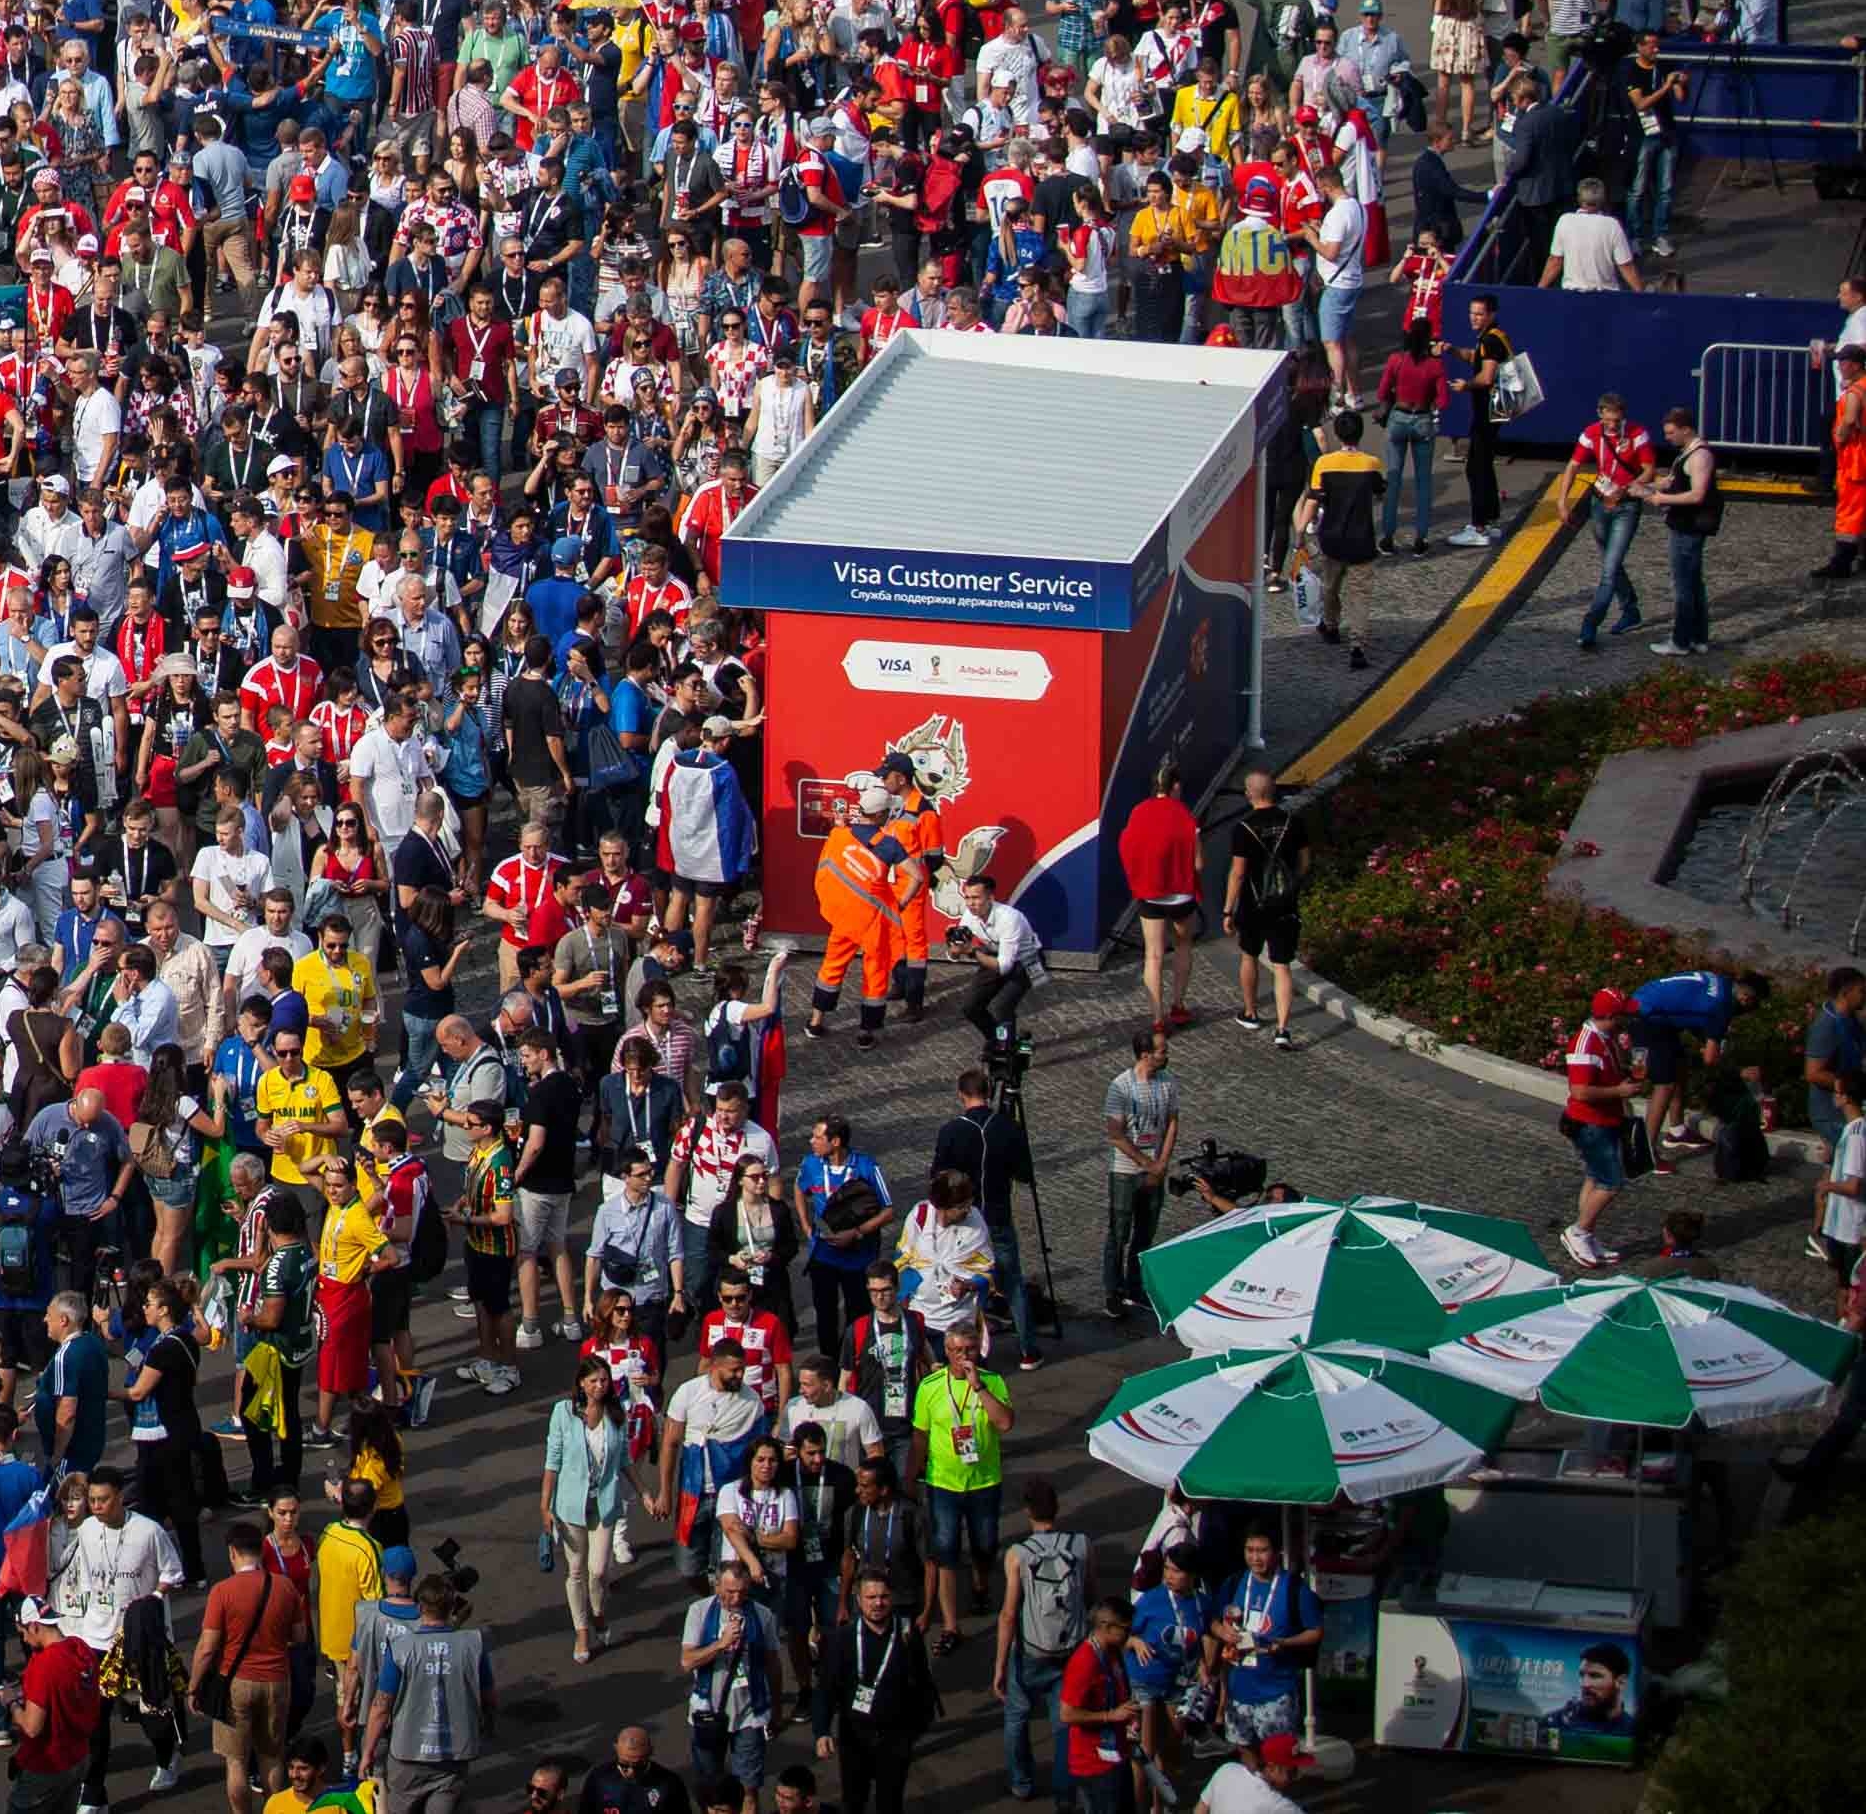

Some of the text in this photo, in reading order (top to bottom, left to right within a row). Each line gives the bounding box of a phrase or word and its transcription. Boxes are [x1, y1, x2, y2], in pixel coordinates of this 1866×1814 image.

[834, 561, 1092, 598] Visa Customer Service
[851, 588, 1075, 613] Служба поддержки держателей карт Visa
[878, 658, 912, 672] VISA
[268, 1249, 287, 1290] HAVAN
